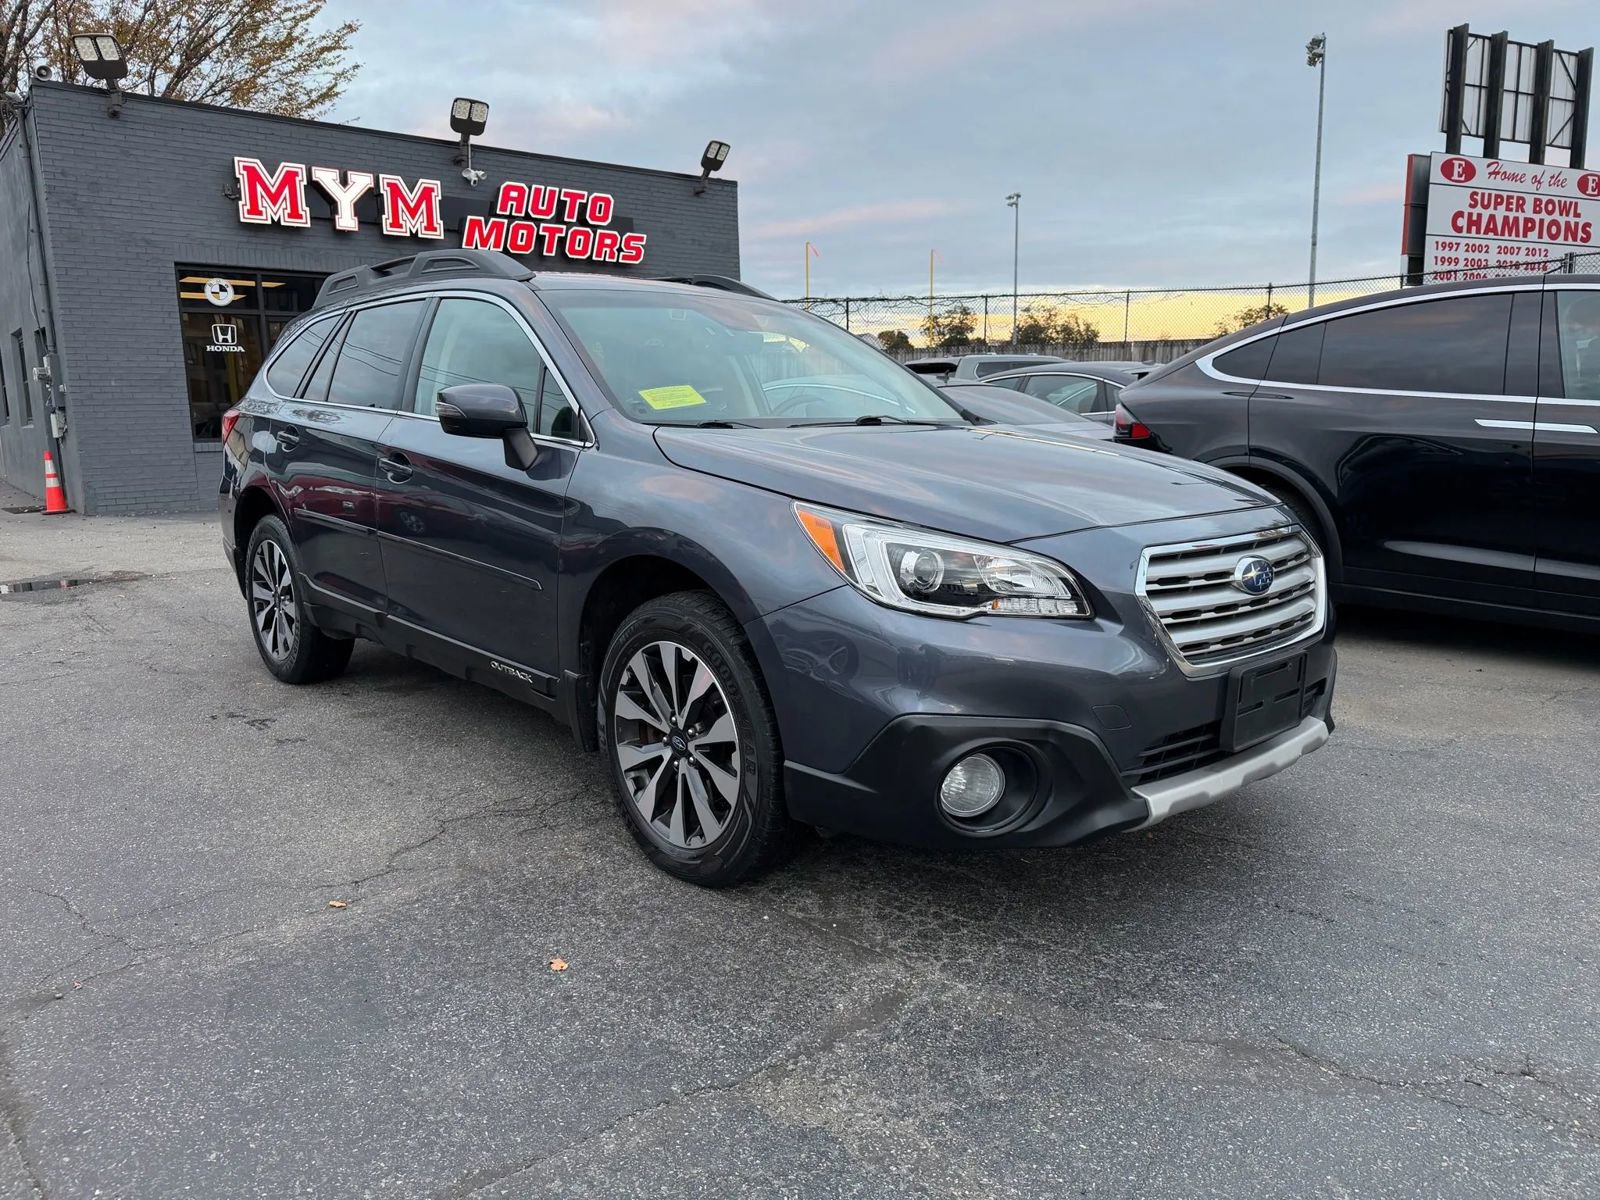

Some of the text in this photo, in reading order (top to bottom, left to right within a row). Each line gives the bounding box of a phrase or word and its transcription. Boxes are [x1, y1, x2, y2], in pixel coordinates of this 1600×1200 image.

[1451, 160, 1466, 181] E
[1486, 161, 1567, 191] Home of the
[233, 156, 445, 240] MYM
[1586, 175, 1600, 196] E
[497, 181, 614, 226] AUTO
[1468, 191, 1581, 218] SUPER BOWL
[462, 216, 647, 264] MOTORS
[1451, 210, 1592, 243] CHAMPIONS
[1434, 256, 1460, 267] 1999
[1463, 258, 1489, 268] 2003
[1435, 241, 1549, 258] 1997 2002 2007 2012
